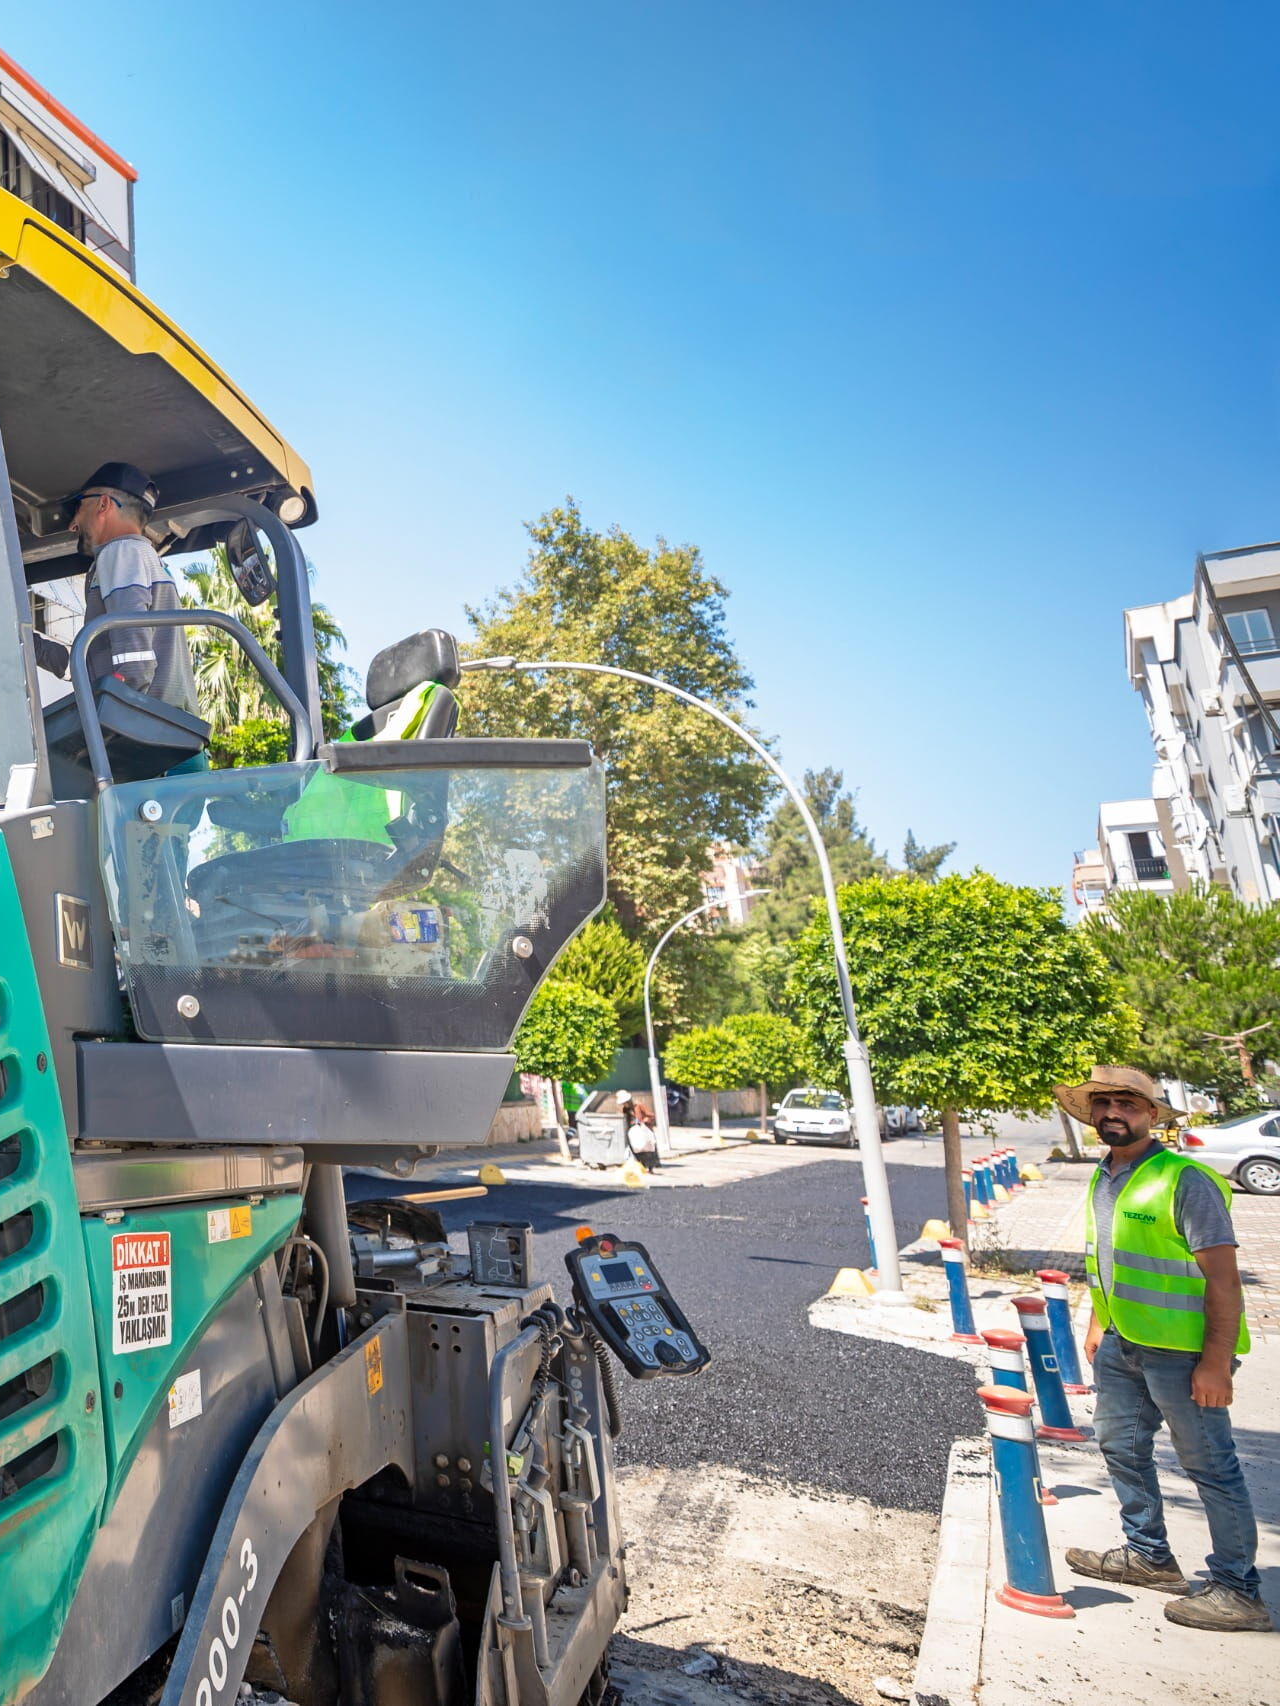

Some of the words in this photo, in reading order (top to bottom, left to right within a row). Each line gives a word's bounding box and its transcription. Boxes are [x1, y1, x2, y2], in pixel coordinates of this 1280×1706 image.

[116, 1237, 160, 1266] DİKKAT
[128, 1269, 166, 1290] MAKİNASINA
[151, 1293, 168, 1312] FAZLA
[120, 1315, 166, 1344] YAKLAŞMA
